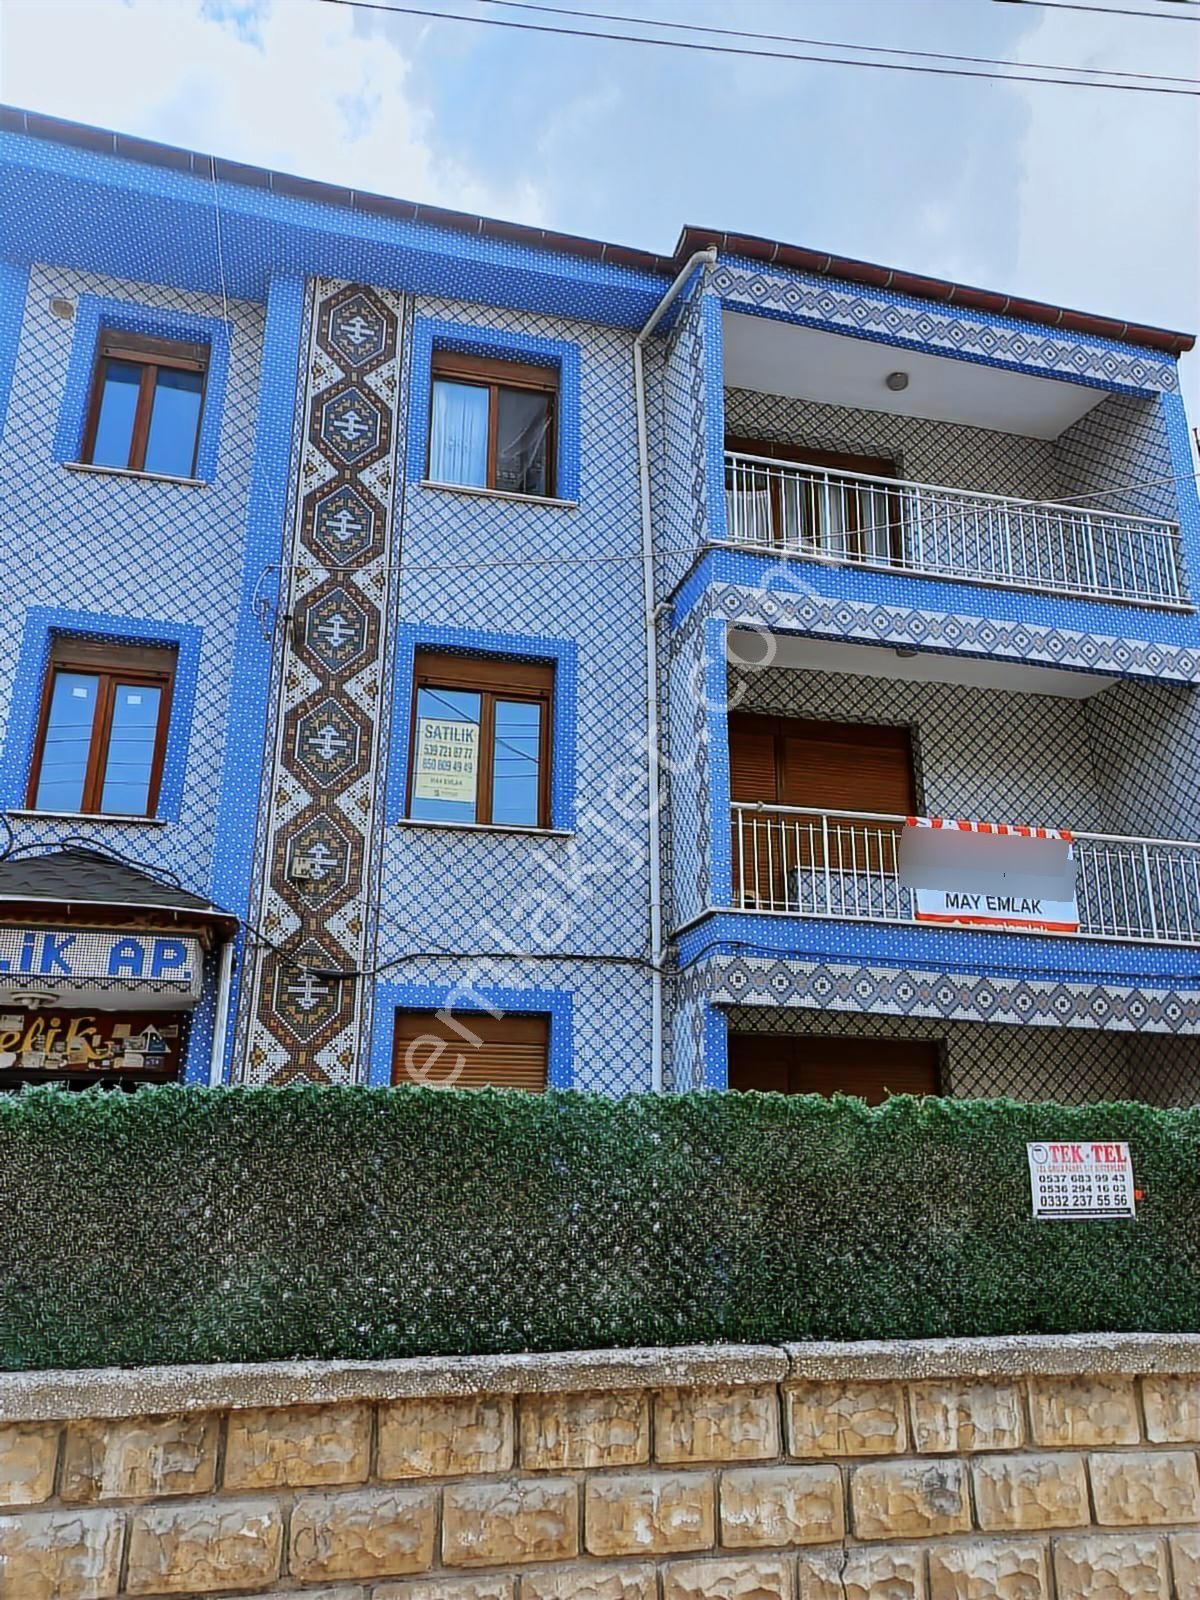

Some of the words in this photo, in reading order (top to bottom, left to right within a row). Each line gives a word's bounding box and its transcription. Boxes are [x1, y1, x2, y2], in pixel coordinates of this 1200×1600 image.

[425, 724, 474, 742] SATILIK
[945, 893, 985, 910] MAY
[986, 896, 1042, 914] EMLAK
[1049, 1145, 1084, 1163] TEK
[1091, 1145, 1127, 1163] TEL
[1112, 1174, 1125, 1182] 43
[1112, 1185, 1126, 1193] 03
[1040, 1196, 1069, 1207] 0332
[1072, 1196, 1093, 1207] 237
[1097, 1195, 1110, 1206] 55
[1114, 1195, 1127, 1206] 56
